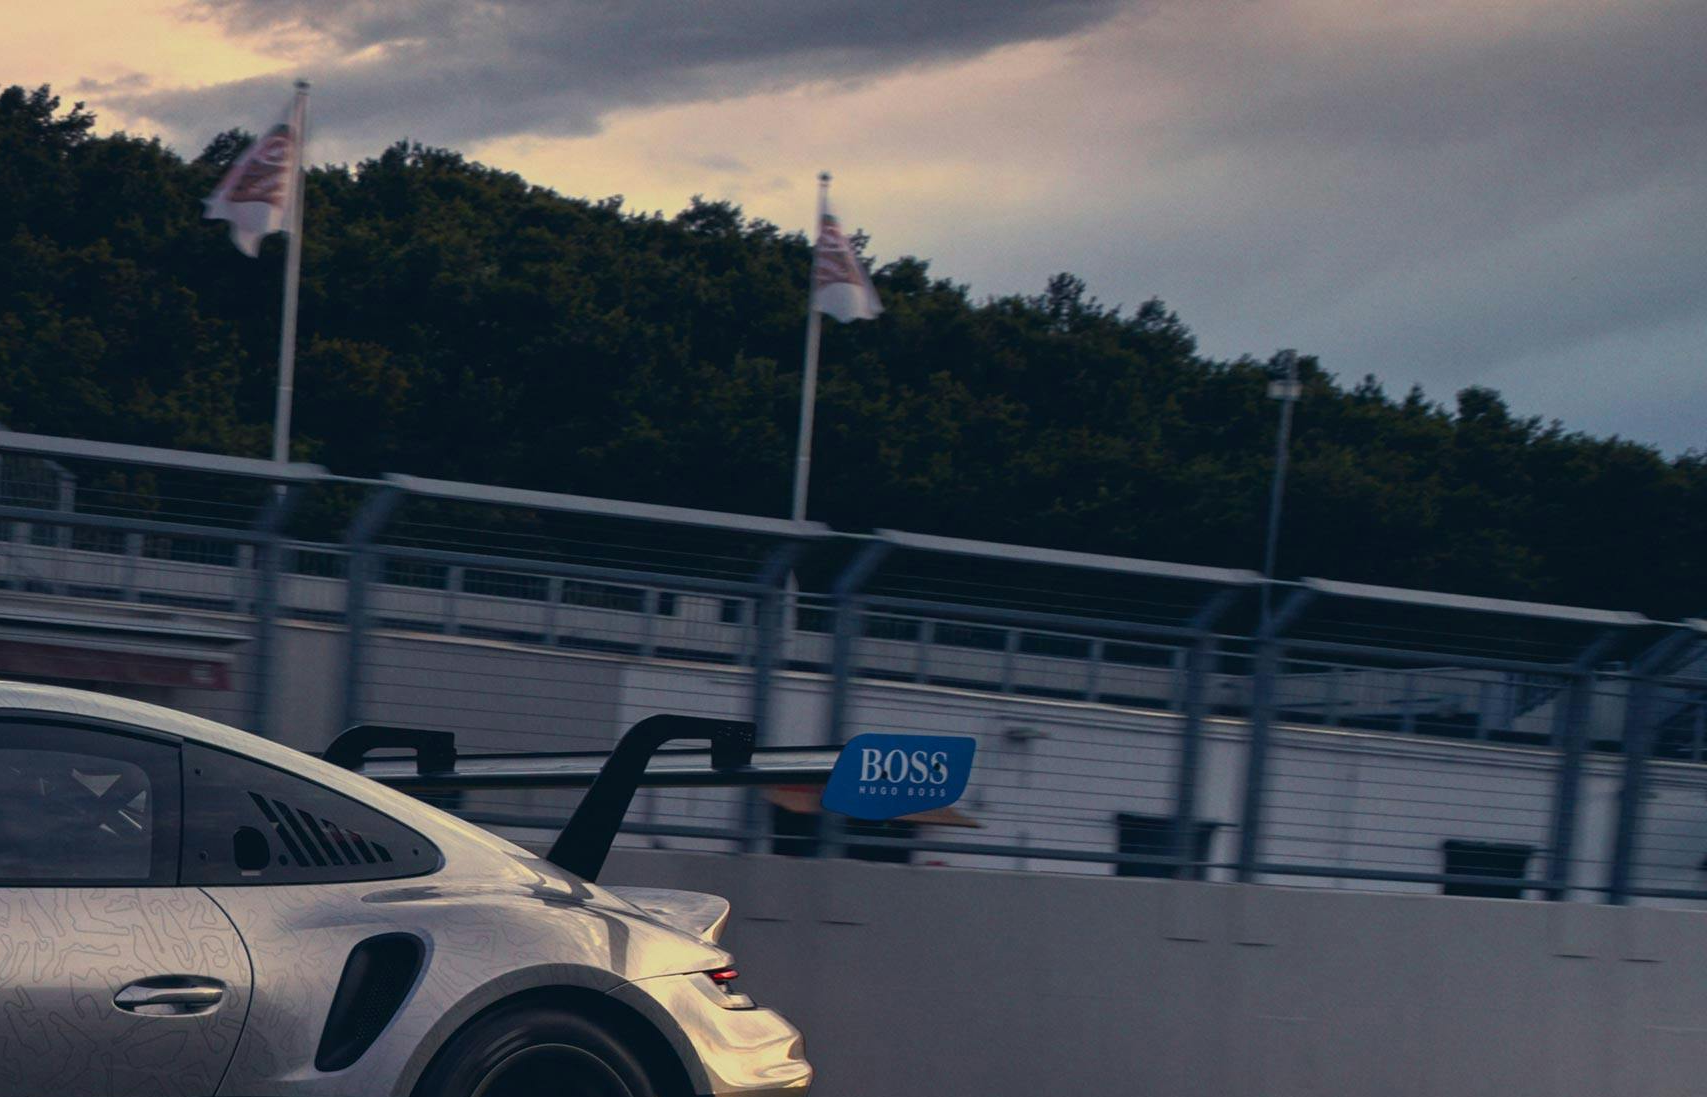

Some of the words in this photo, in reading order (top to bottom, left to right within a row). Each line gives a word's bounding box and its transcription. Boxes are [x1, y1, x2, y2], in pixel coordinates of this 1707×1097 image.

[859, 748, 949, 784] BOSS
[859, 785, 898, 796] HUGO
[907, 786, 946, 797] BOSS
